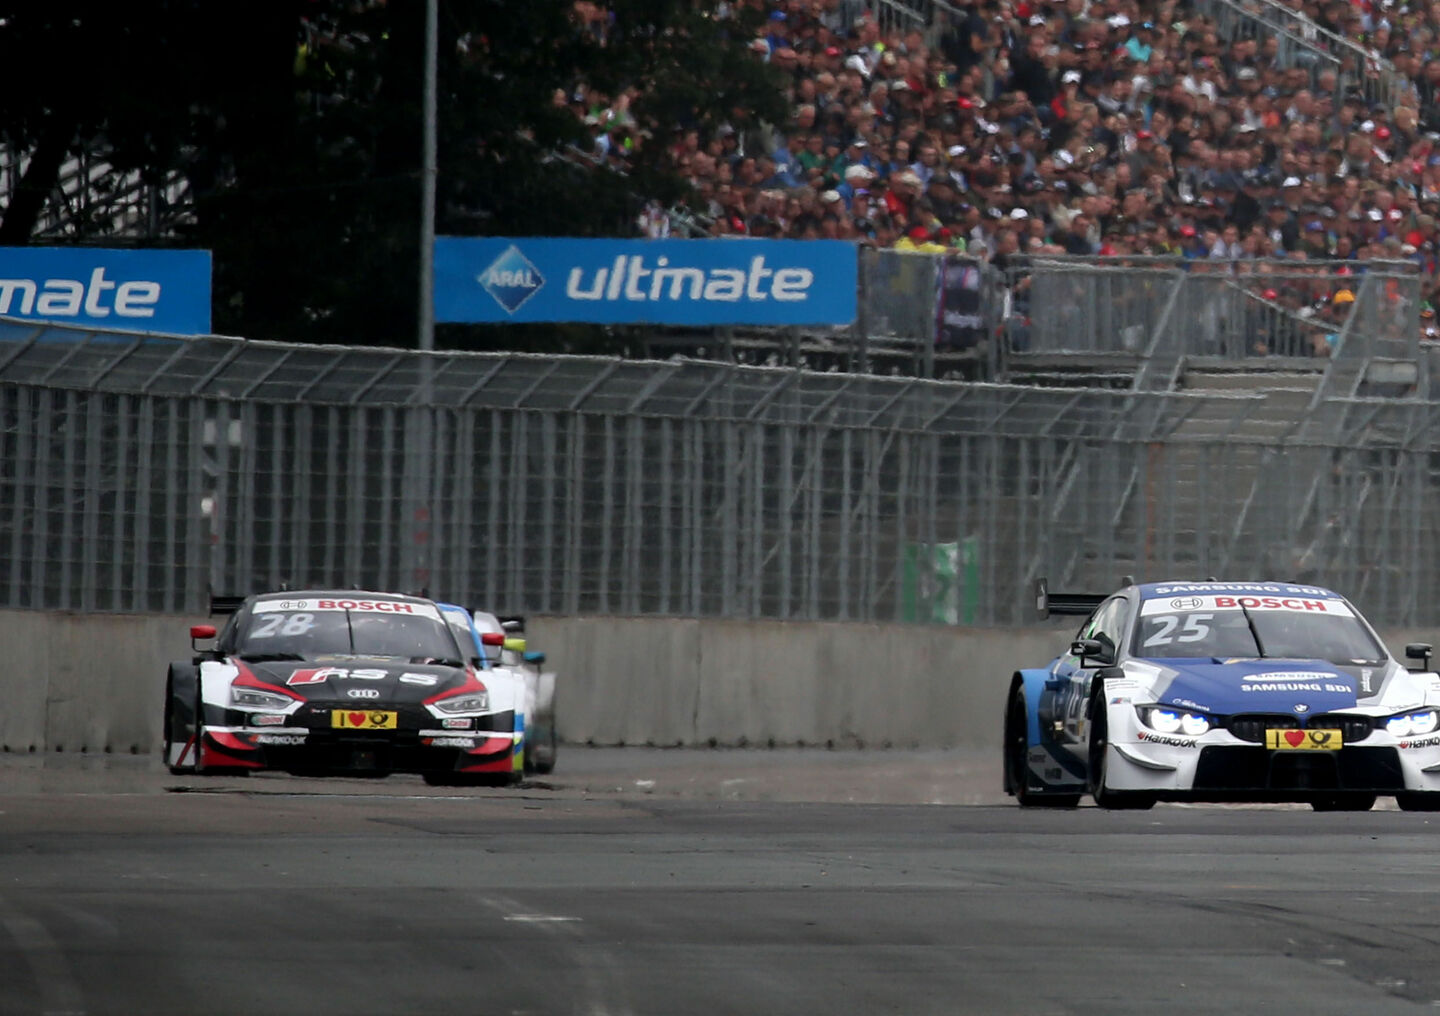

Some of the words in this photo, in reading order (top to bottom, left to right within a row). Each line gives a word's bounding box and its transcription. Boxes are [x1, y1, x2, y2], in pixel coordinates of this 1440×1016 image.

[487, 269, 537, 289] ARAL
[566, 254, 814, 302] ultimate
[1155, 584, 1281, 595] SAMSUNG
[318, 600, 413, 614] BOSCH
[1215, 597, 1327, 612] BOSCH
[250, 612, 315, 639] 28
[1143, 613, 1214, 648] 25
[1240, 683, 1322, 692] SAMSUNG
[1325, 683, 1352, 693] SDI
